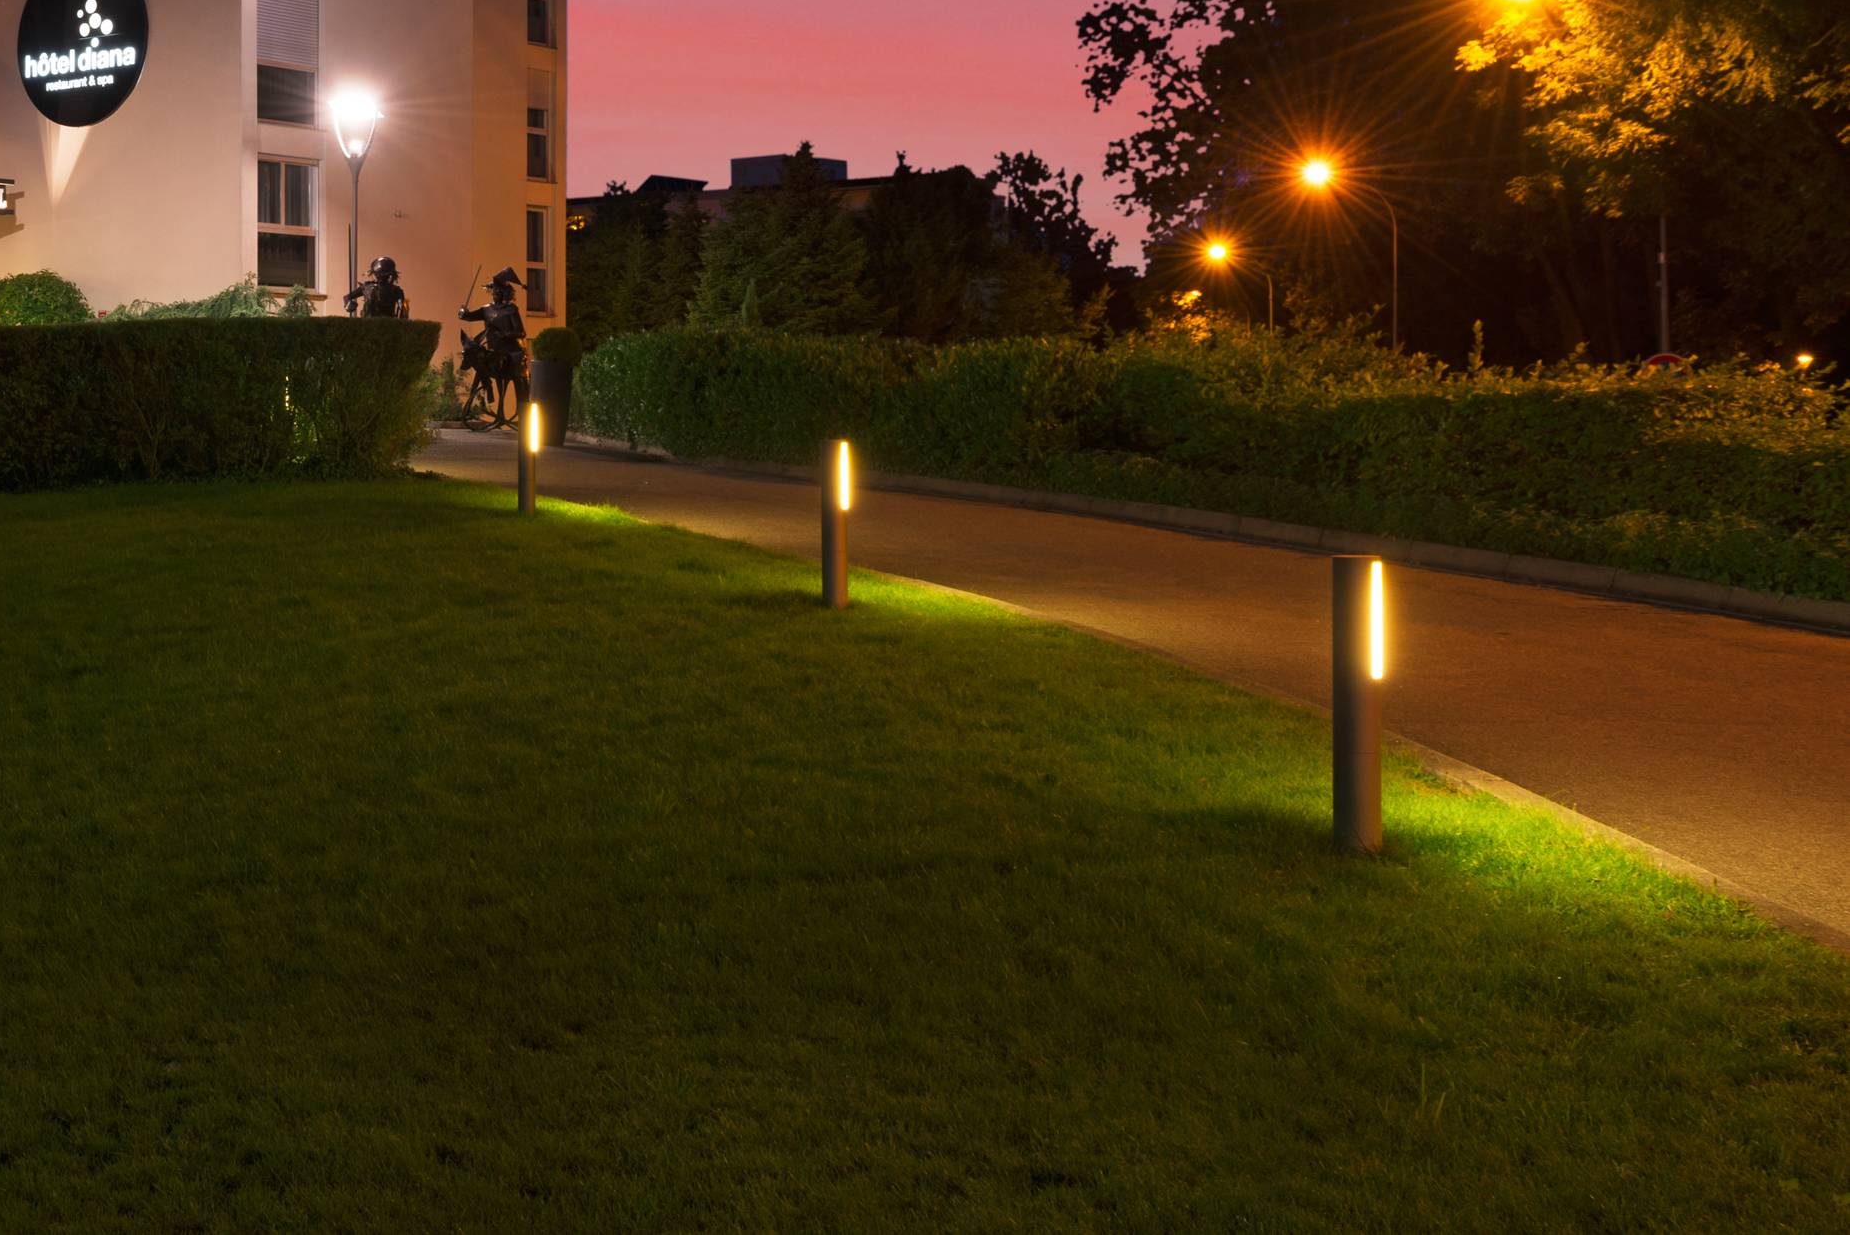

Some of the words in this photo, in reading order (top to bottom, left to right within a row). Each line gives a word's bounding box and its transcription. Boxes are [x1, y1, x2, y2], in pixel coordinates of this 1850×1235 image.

[24, 49, 76, 79] hôtel
[77, 37, 136, 71] diana
[45, 76, 88, 91] restaurant
[96, 74, 114, 88] spa
